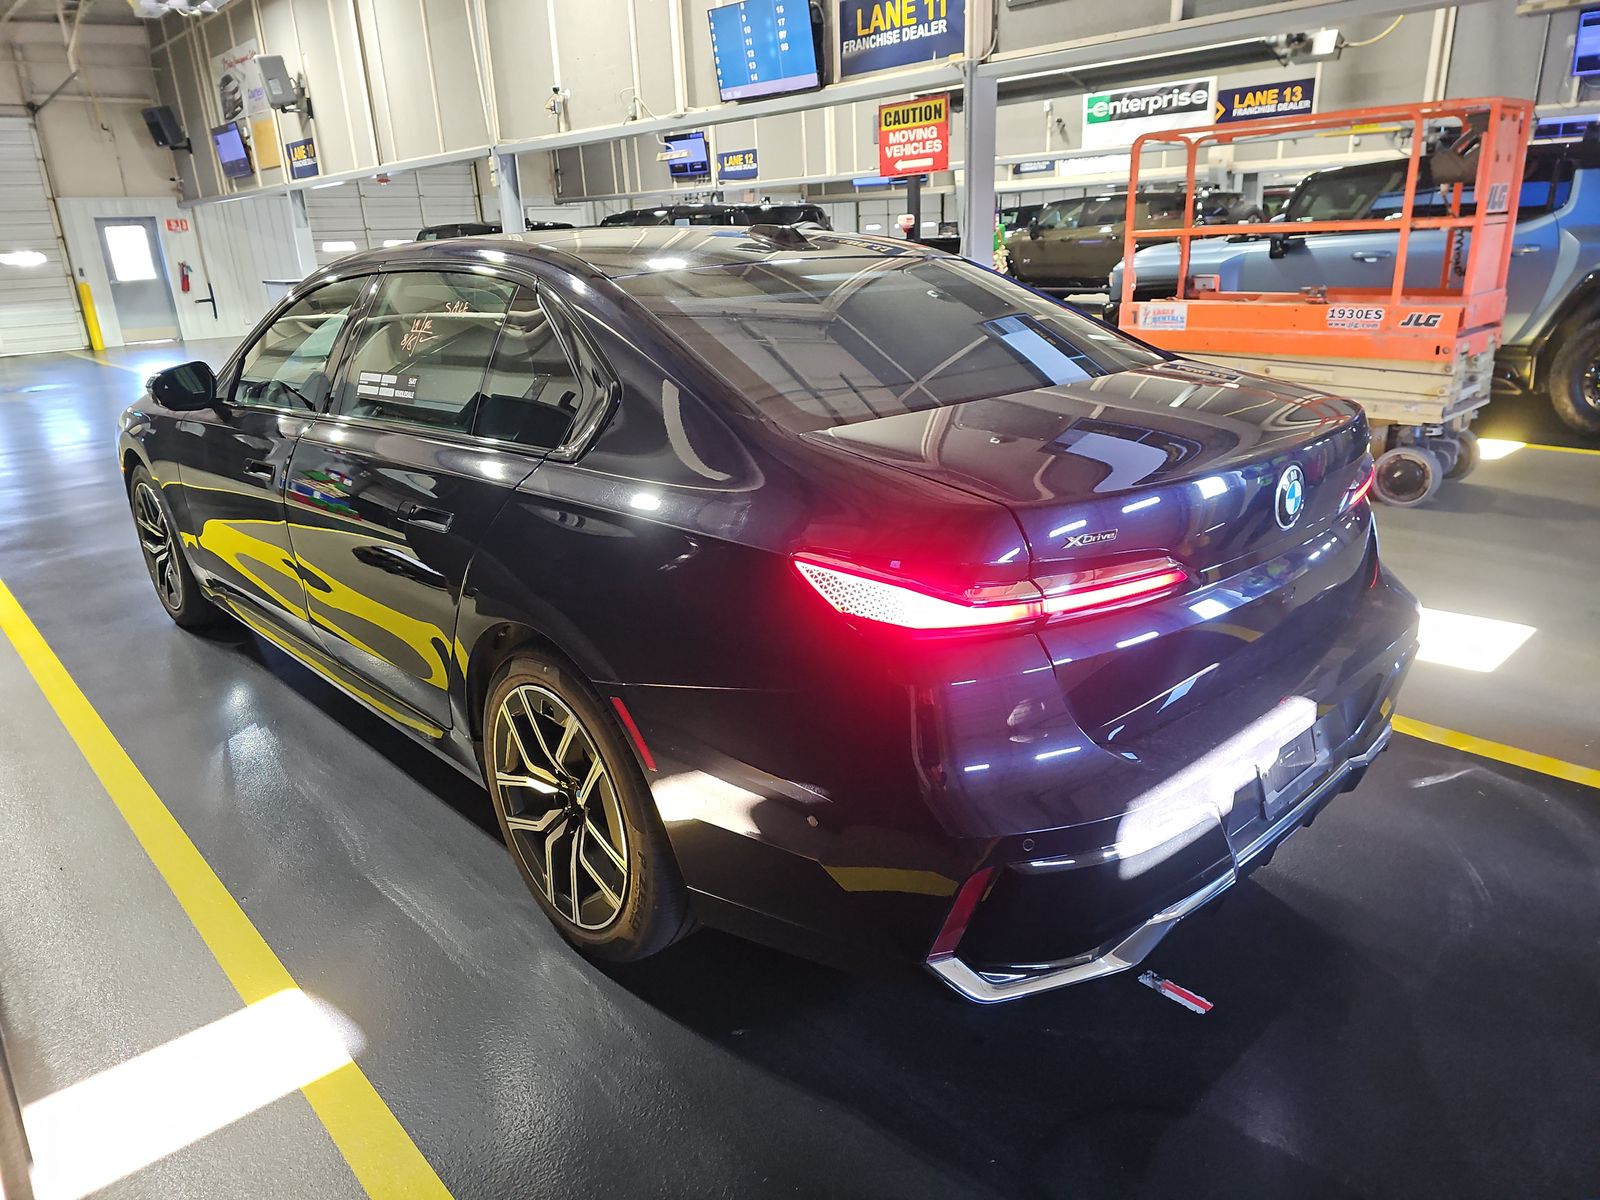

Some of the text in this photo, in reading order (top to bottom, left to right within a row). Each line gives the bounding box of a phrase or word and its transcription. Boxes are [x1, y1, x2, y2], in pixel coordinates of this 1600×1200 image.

[777, 18, 786, 26] 17
[857, 0, 947, 36] LANE 11
[745, 38, 753, 46] 11
[842, 19, 948, 54] FRANCHISE DEALER
[747, 49, 755, 58] 12
[748, 61, 757, 70] 13
[750, 73, 759, 81] 14
[1088, 88, 1209, 118] enterprise
[1233, 86, 1303, 109] LANE 13
[884, 103, 942, 127] CAUTION
[1232, 99, 1311, 117] FRANCHISE DEALER
[888, 125, 938, 145] MOVING
[884, 139, 943, 158] VEHICLES
[724, 154, 744, 167] LANE
[745, 153, 754, 164] 12
[1486, 184, 1509, 210] JLG
[1328, 308, 1383, 319] 1930ES
[1400, 313, 1441, 327] JLG
